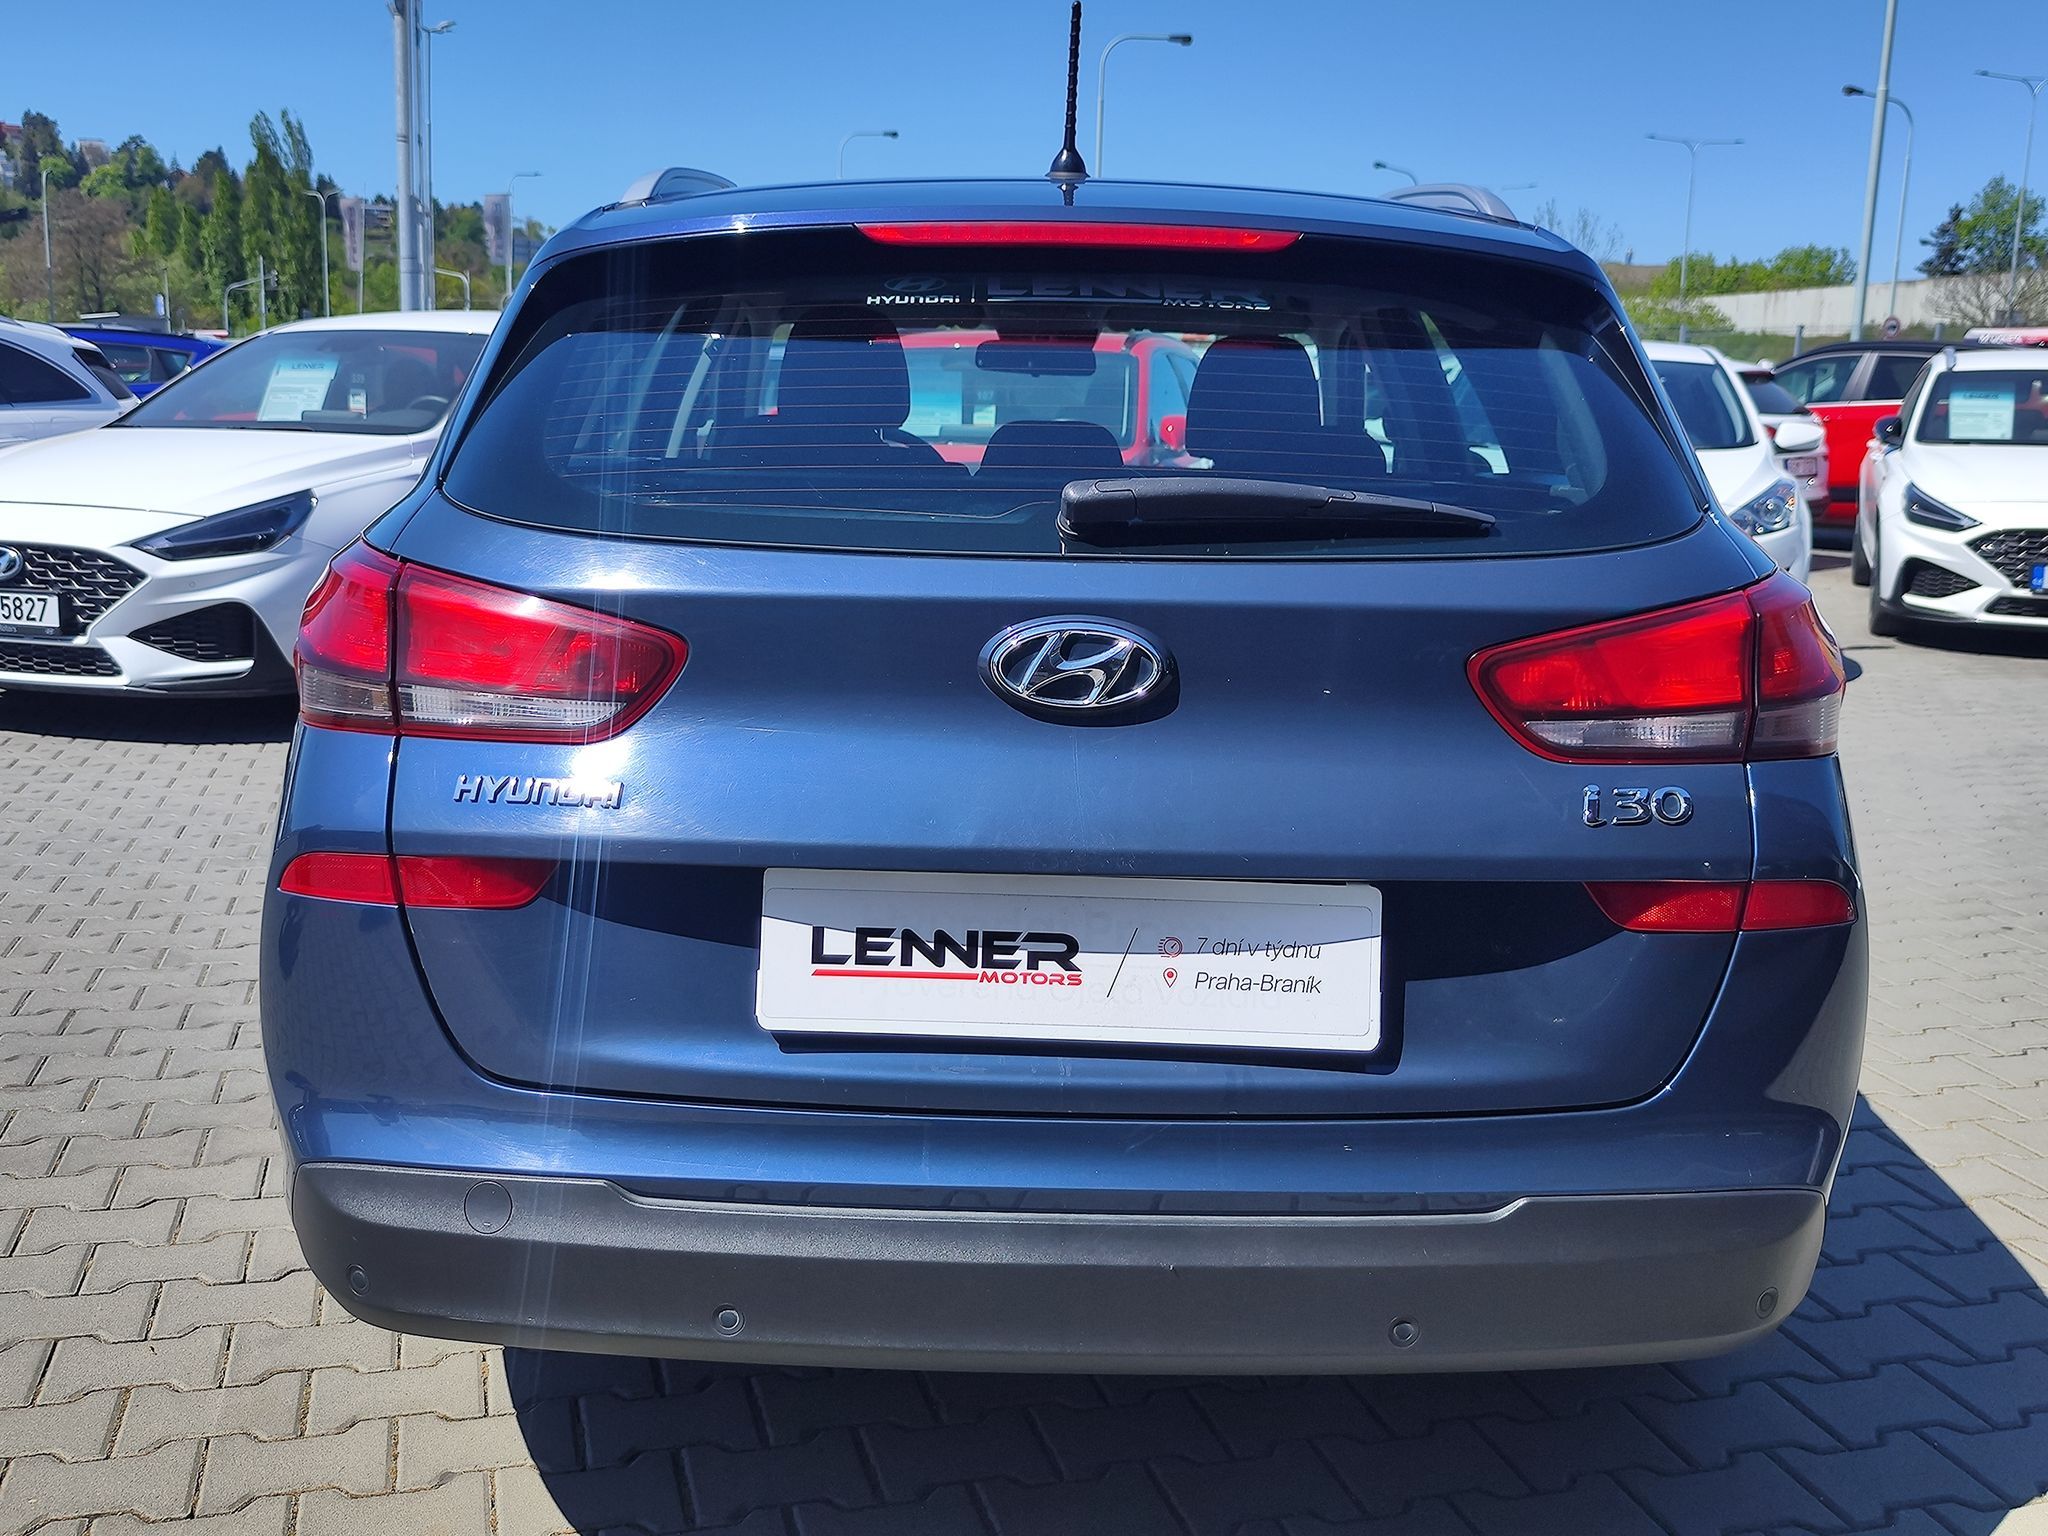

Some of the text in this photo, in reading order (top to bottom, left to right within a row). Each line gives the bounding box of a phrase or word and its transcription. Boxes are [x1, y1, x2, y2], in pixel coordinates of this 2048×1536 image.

[866, 295, 961, 305] HYUNDAI
[0, 595, 48, 622] 5827
[810, 926, 1083, 973] LENNER
[1196, 937, 1322, 962] 7 dní v týdnu
[979, 970, 1083, 986] MOTORS
[1194, 971, 1323, 994] Praha-Braník
